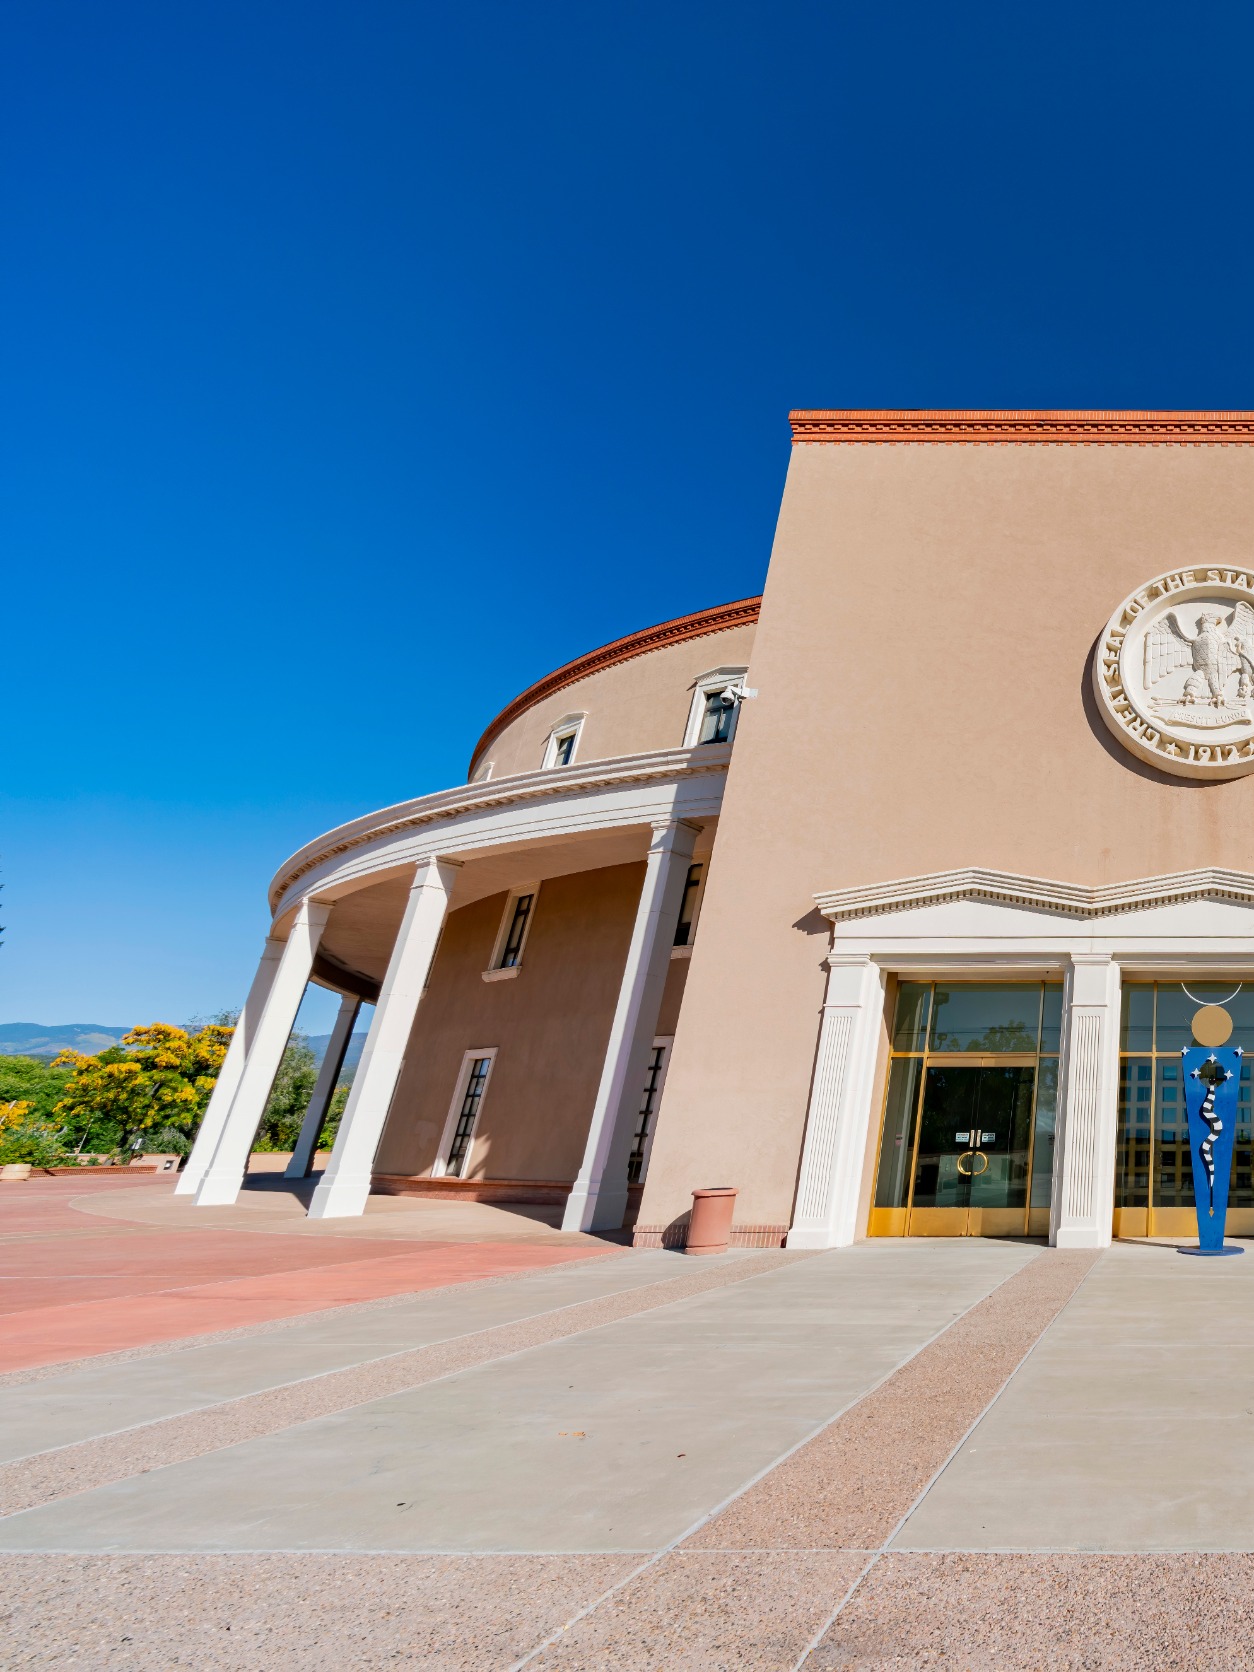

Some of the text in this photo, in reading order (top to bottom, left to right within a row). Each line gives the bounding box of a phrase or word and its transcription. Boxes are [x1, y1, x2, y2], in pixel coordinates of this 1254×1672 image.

[1153, 571, 1196, 595] THE
[1125, 592, 1150, 616] OF
[1103, 625, 1130, 677] SEAL
[1109, 686, 1160, 748] GREAT
[1189, 745, 1240, 762] 1912
